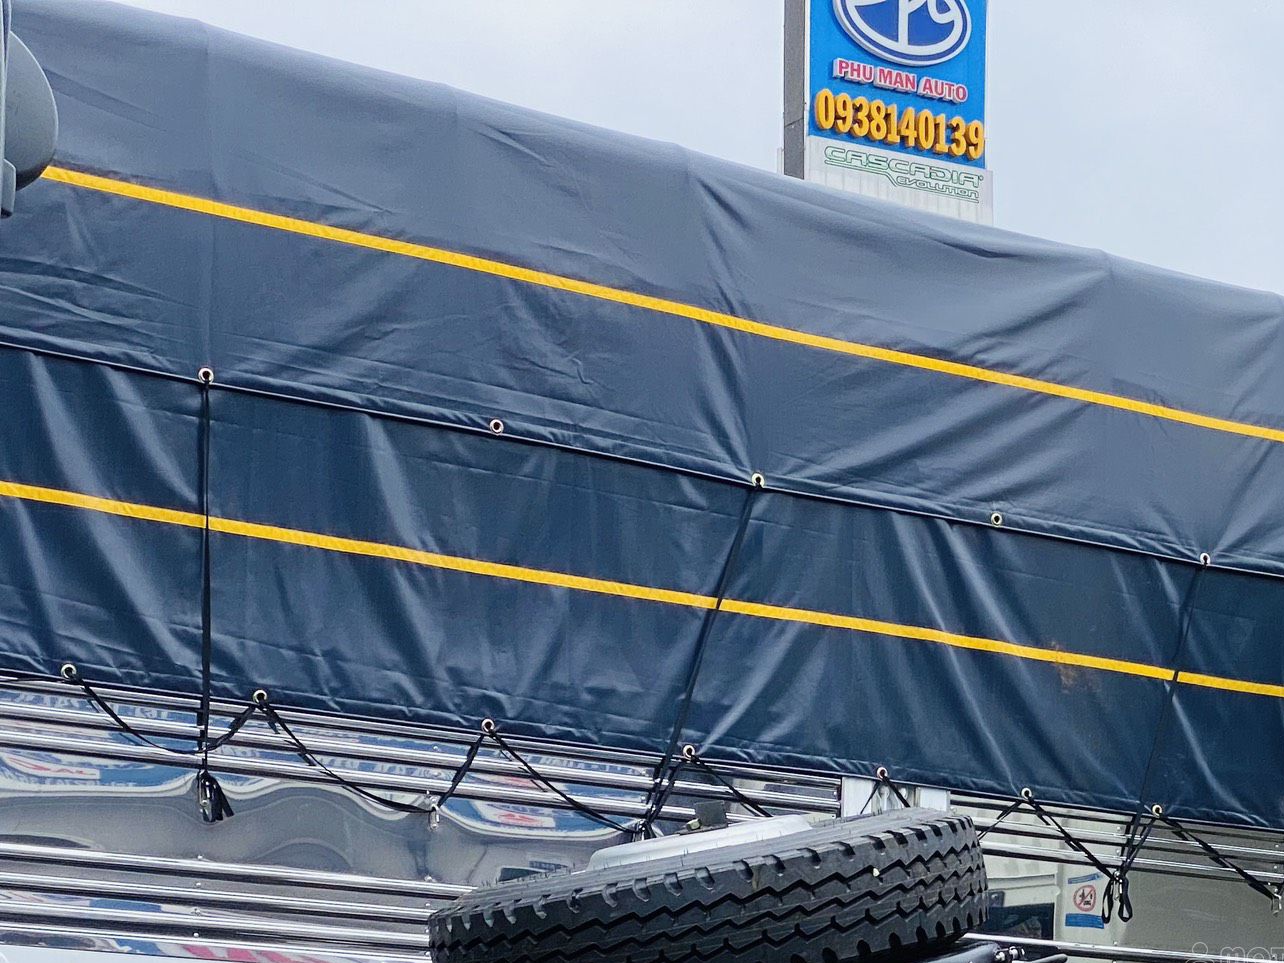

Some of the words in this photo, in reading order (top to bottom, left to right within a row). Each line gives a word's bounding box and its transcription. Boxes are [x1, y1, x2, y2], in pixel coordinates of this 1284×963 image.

[835, 58, 874, 83] PHU
[876, 66, 917, 91] MAN
[920, 77, 968, 102] AUTO
[815, 88, 984, 160] 0938140139
[824, 146, 980, 187] CASCADIA
